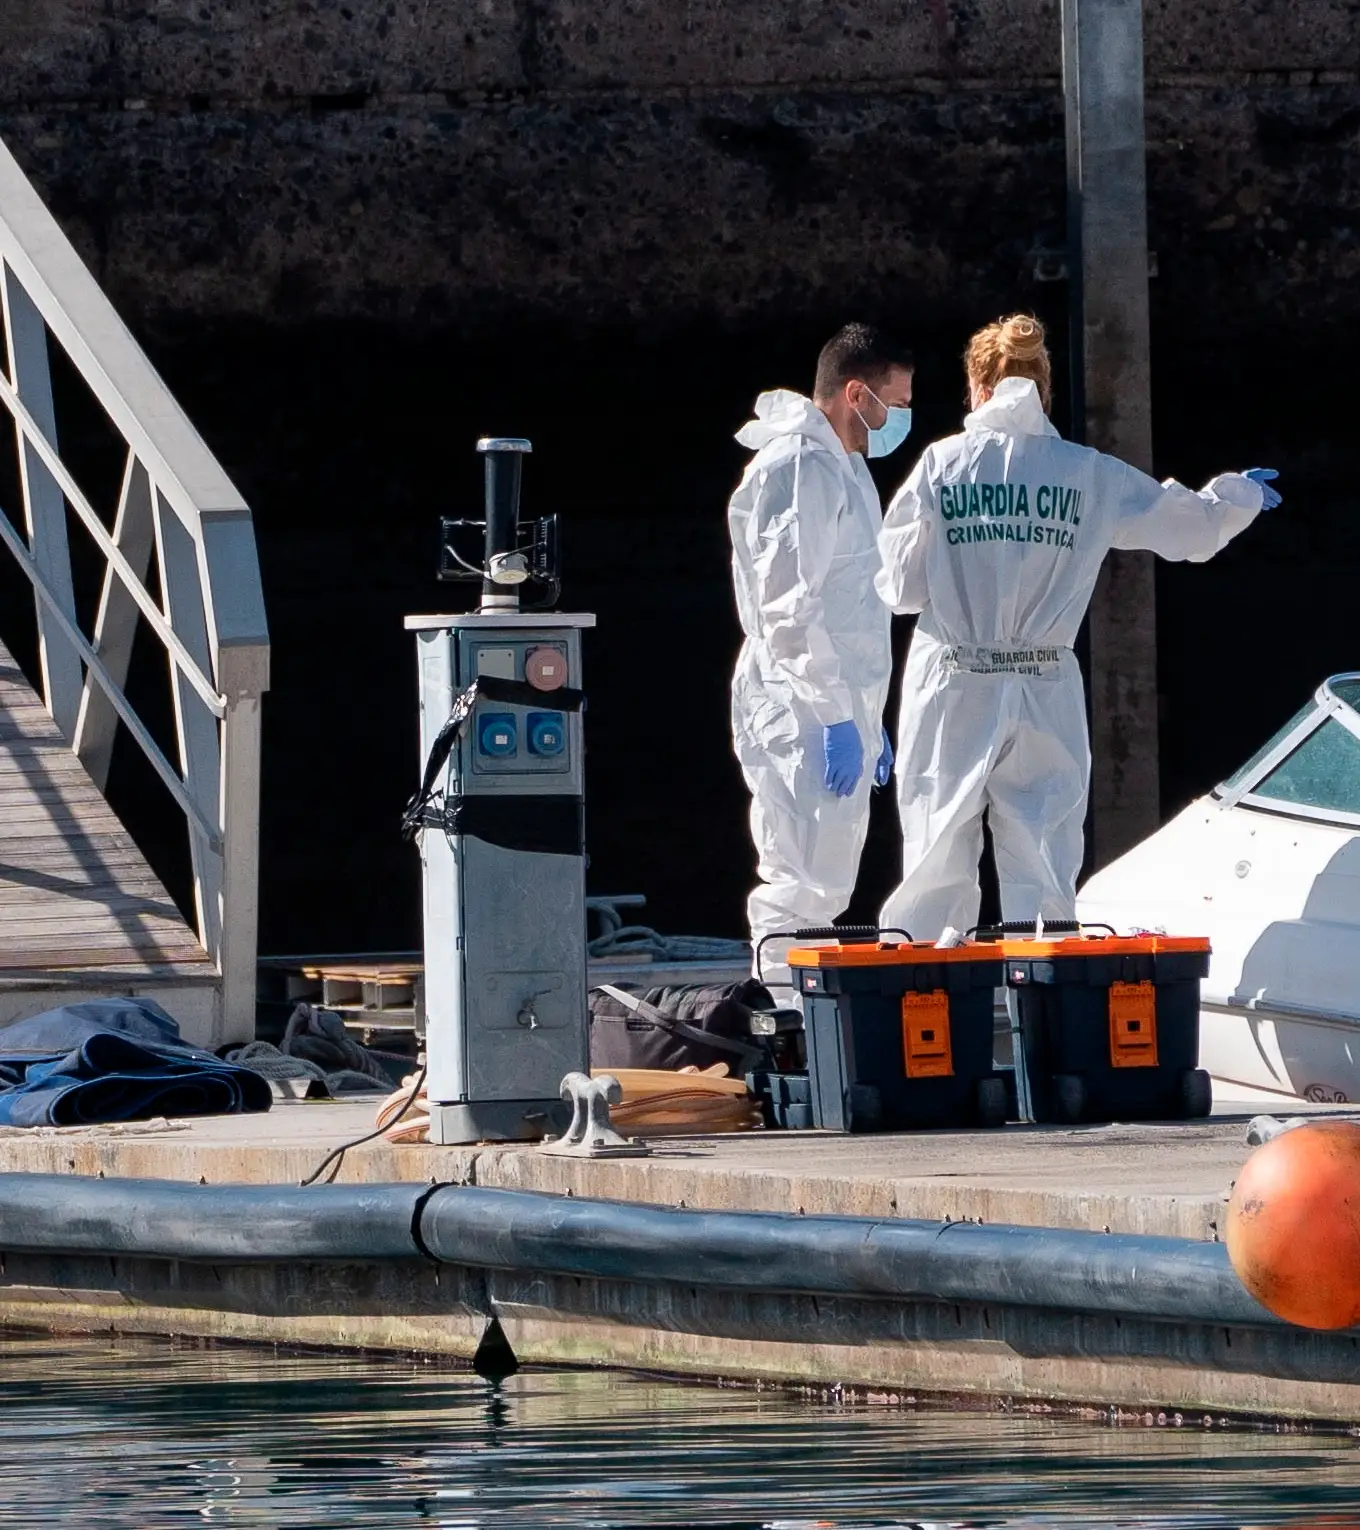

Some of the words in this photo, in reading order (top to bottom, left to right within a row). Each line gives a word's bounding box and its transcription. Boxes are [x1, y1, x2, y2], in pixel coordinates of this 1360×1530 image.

[940, 483, 1030, 520] GUARDIA
[1036, 485, 1081, 526] CIVIL
[946, 521, 1075, 550] CRIMINALÍSTICA
[991, 649, 1034, 665] GUARDIA
[1037, 649, 1060, 662] CIVIL
